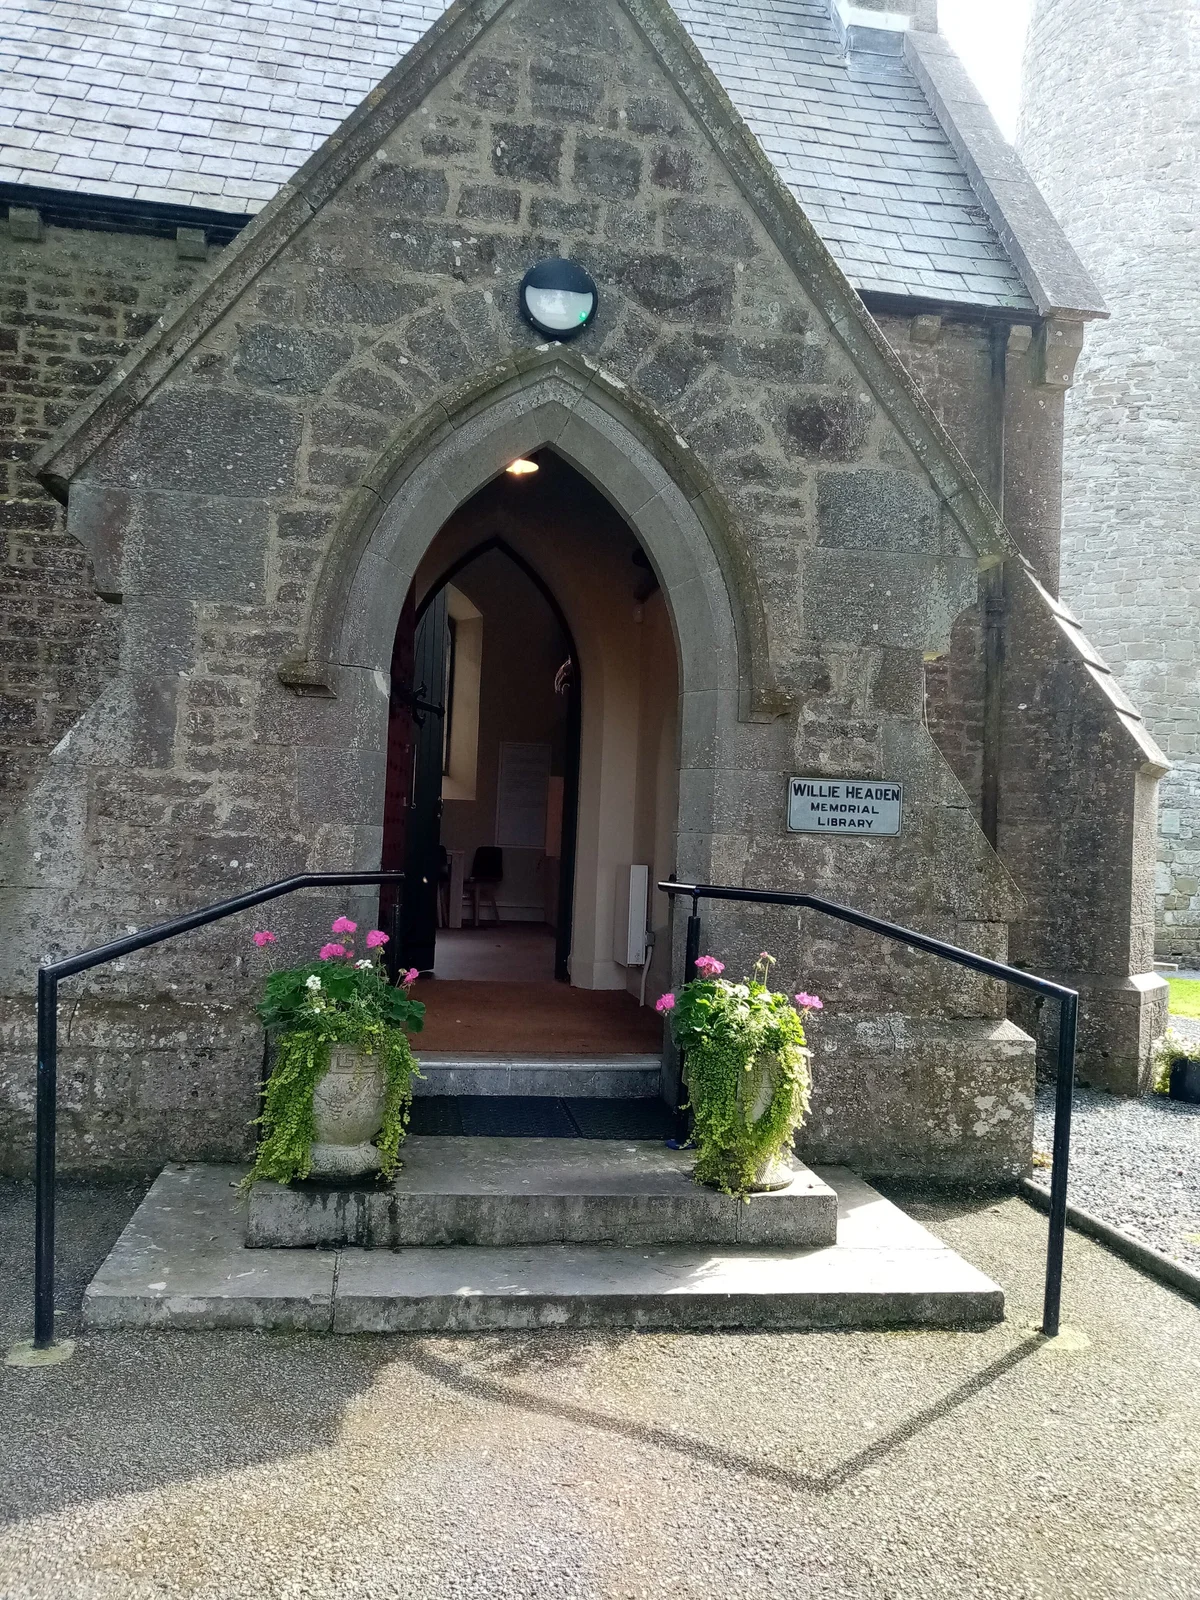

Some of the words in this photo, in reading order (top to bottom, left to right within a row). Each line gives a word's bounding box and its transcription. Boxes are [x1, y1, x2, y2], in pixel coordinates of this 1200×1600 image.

[793, 783, 840, 798] WILLIE
[846, 786, 900, 801] HEADEN
[810, 802, 879, 814] MEMORIAL
[817, 817, 874, 828] LIBRARY
